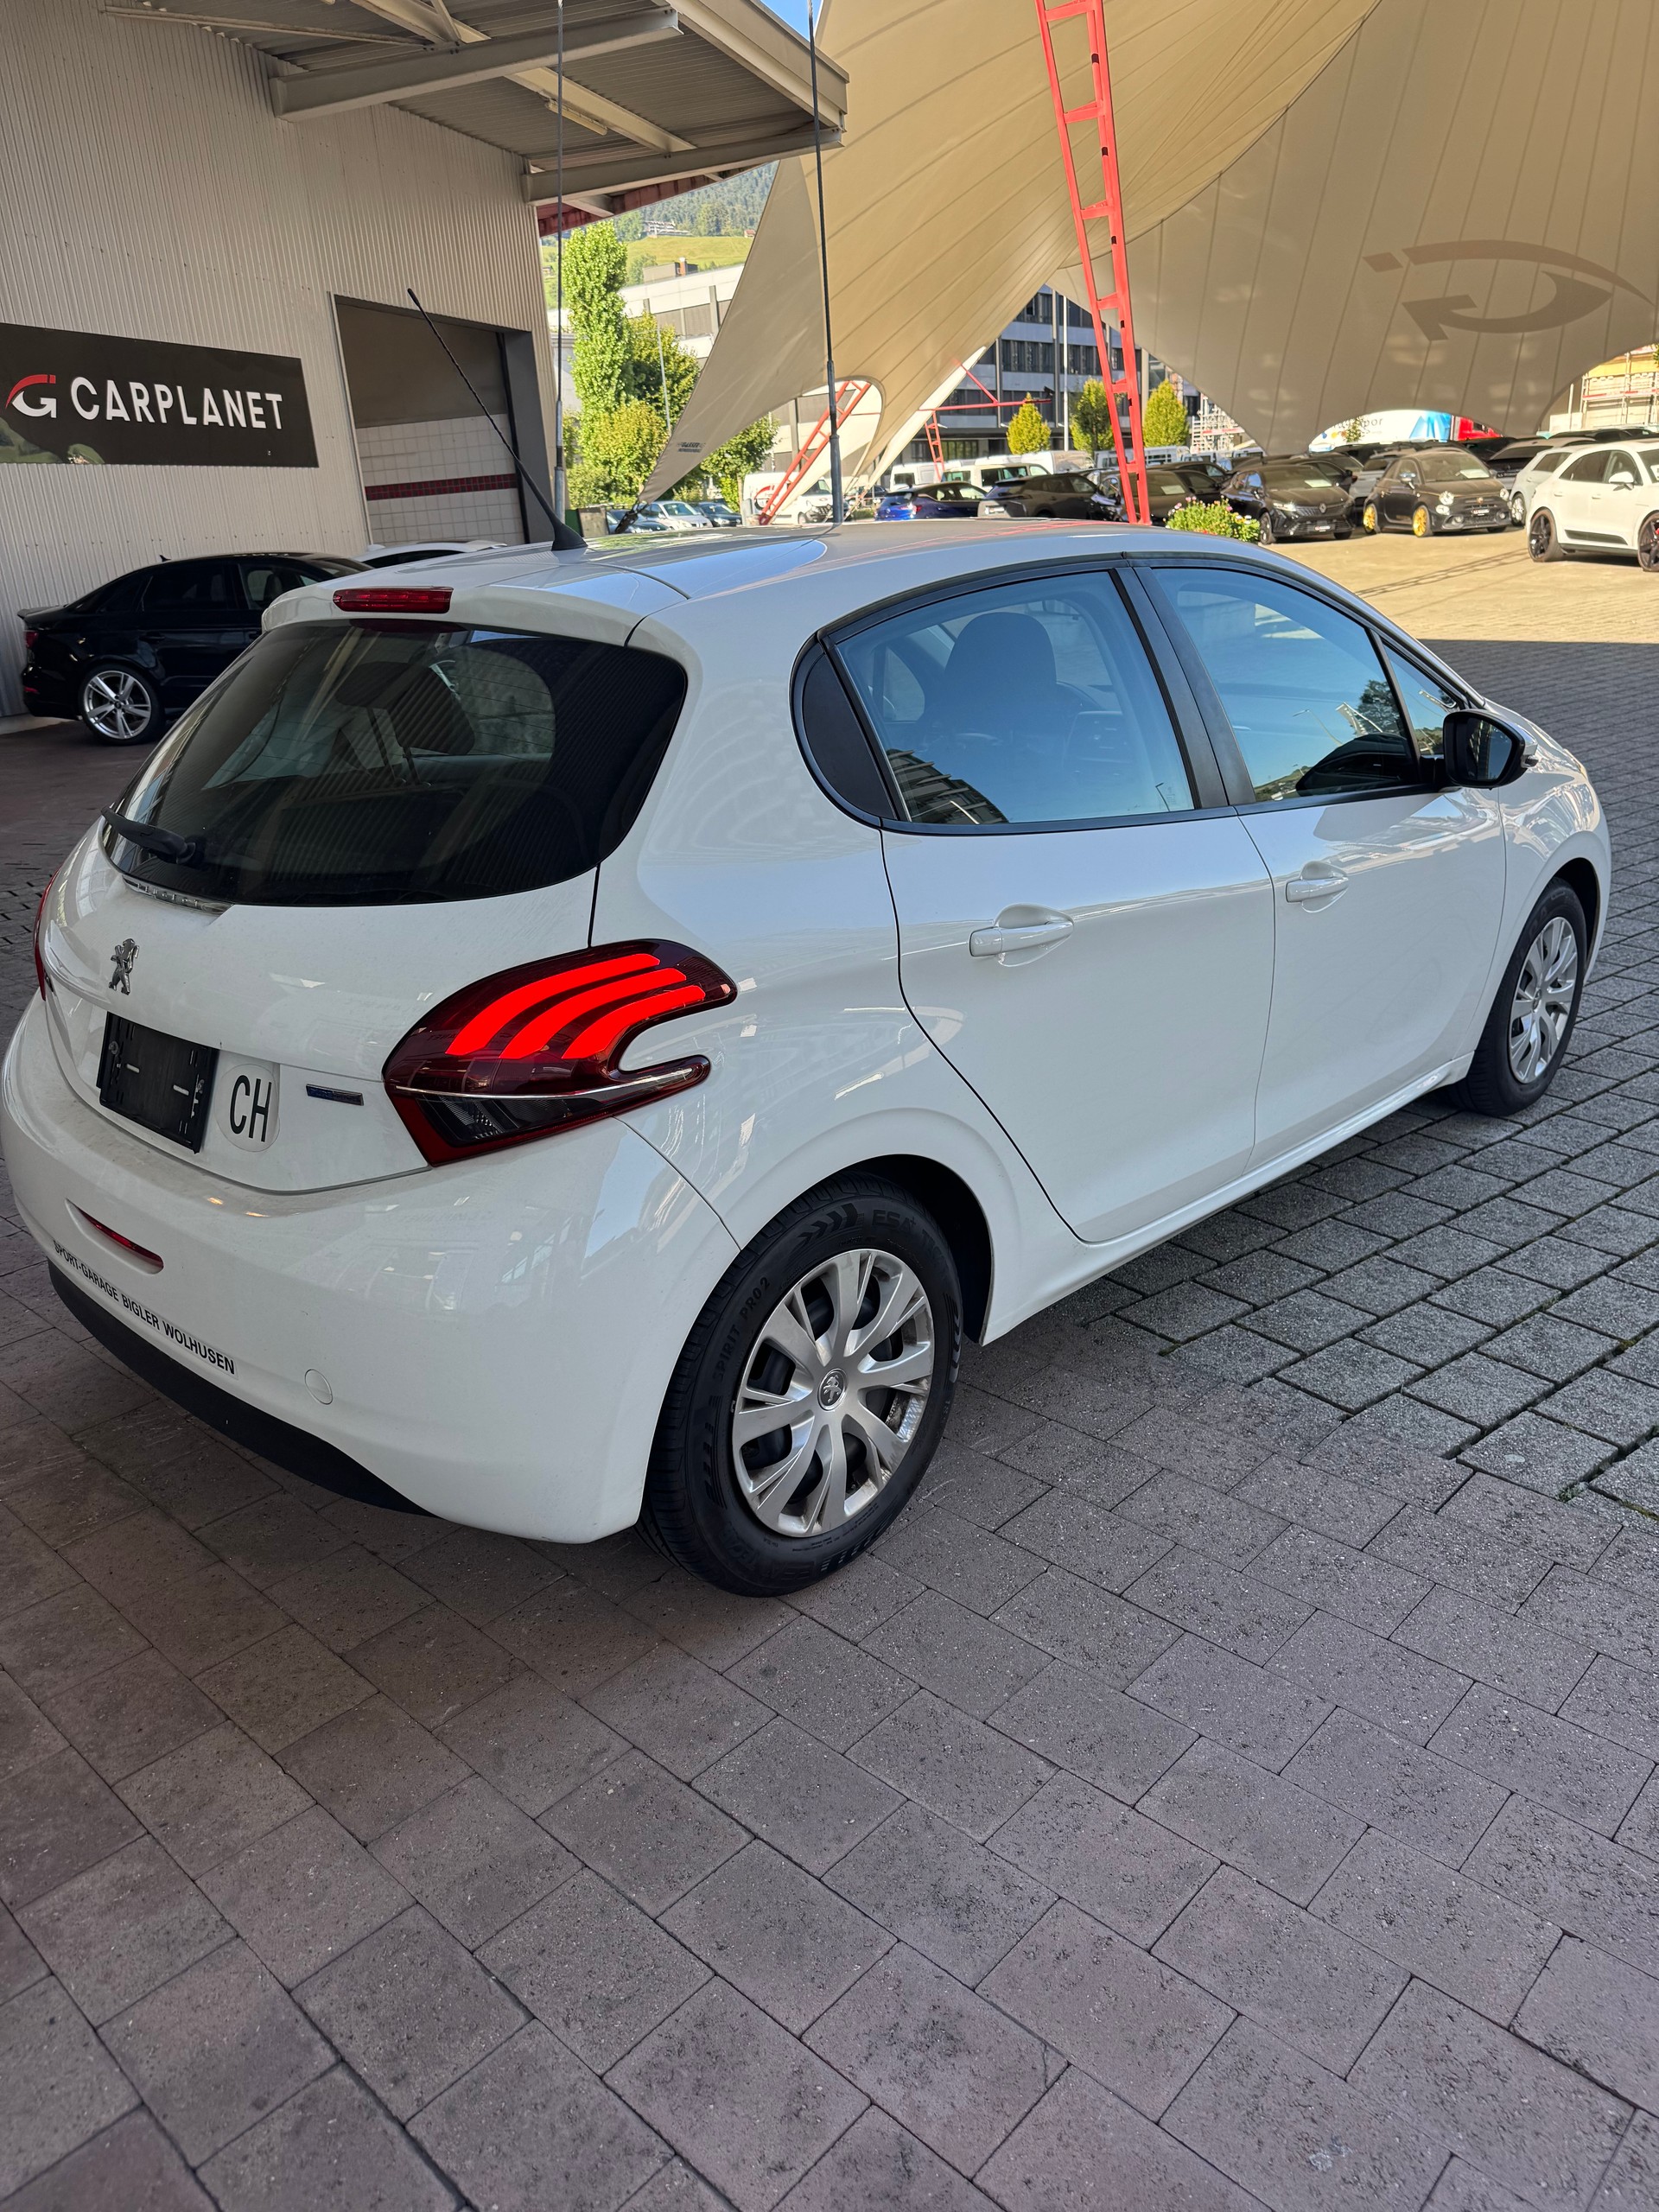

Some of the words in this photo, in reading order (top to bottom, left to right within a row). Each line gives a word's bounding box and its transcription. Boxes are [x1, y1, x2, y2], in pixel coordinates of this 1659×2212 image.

[70, 376, 283, 429] CARPLANET
[229, 1074, 273, 1143] CH
[53, 1240, 120, 1302] SPORT-GARAGE
[121, 1294, 161, 1331] BIGLER
[162, 1320, 236, 1375] WOLHUSEN
[713, 1323, 742, 1382] SPIRIT
